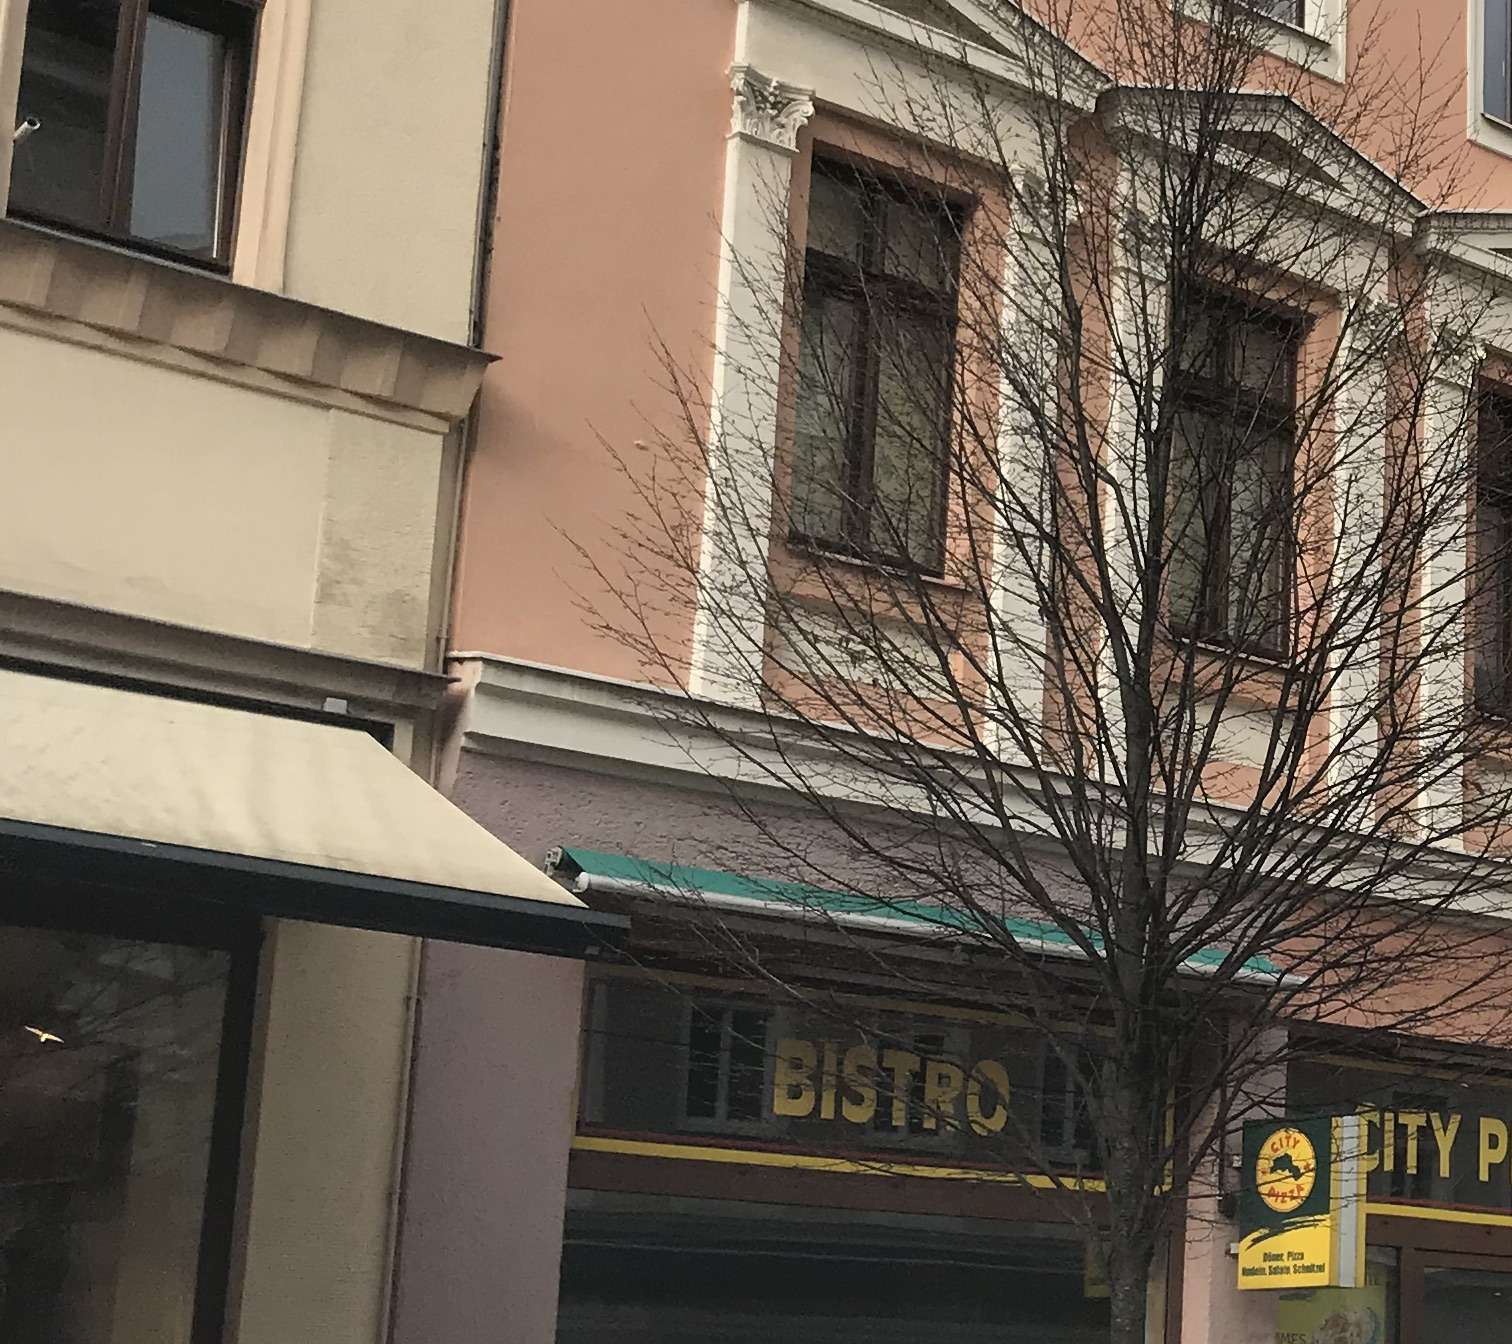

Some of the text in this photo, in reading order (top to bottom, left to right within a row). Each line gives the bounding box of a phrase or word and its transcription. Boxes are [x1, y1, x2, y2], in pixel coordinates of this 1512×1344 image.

[773, 1039, 1010, 1137] BISTRO
[1270, 1133, 1301, 1155] CITY
[1356, 1103, 1461, 1178] CITY
